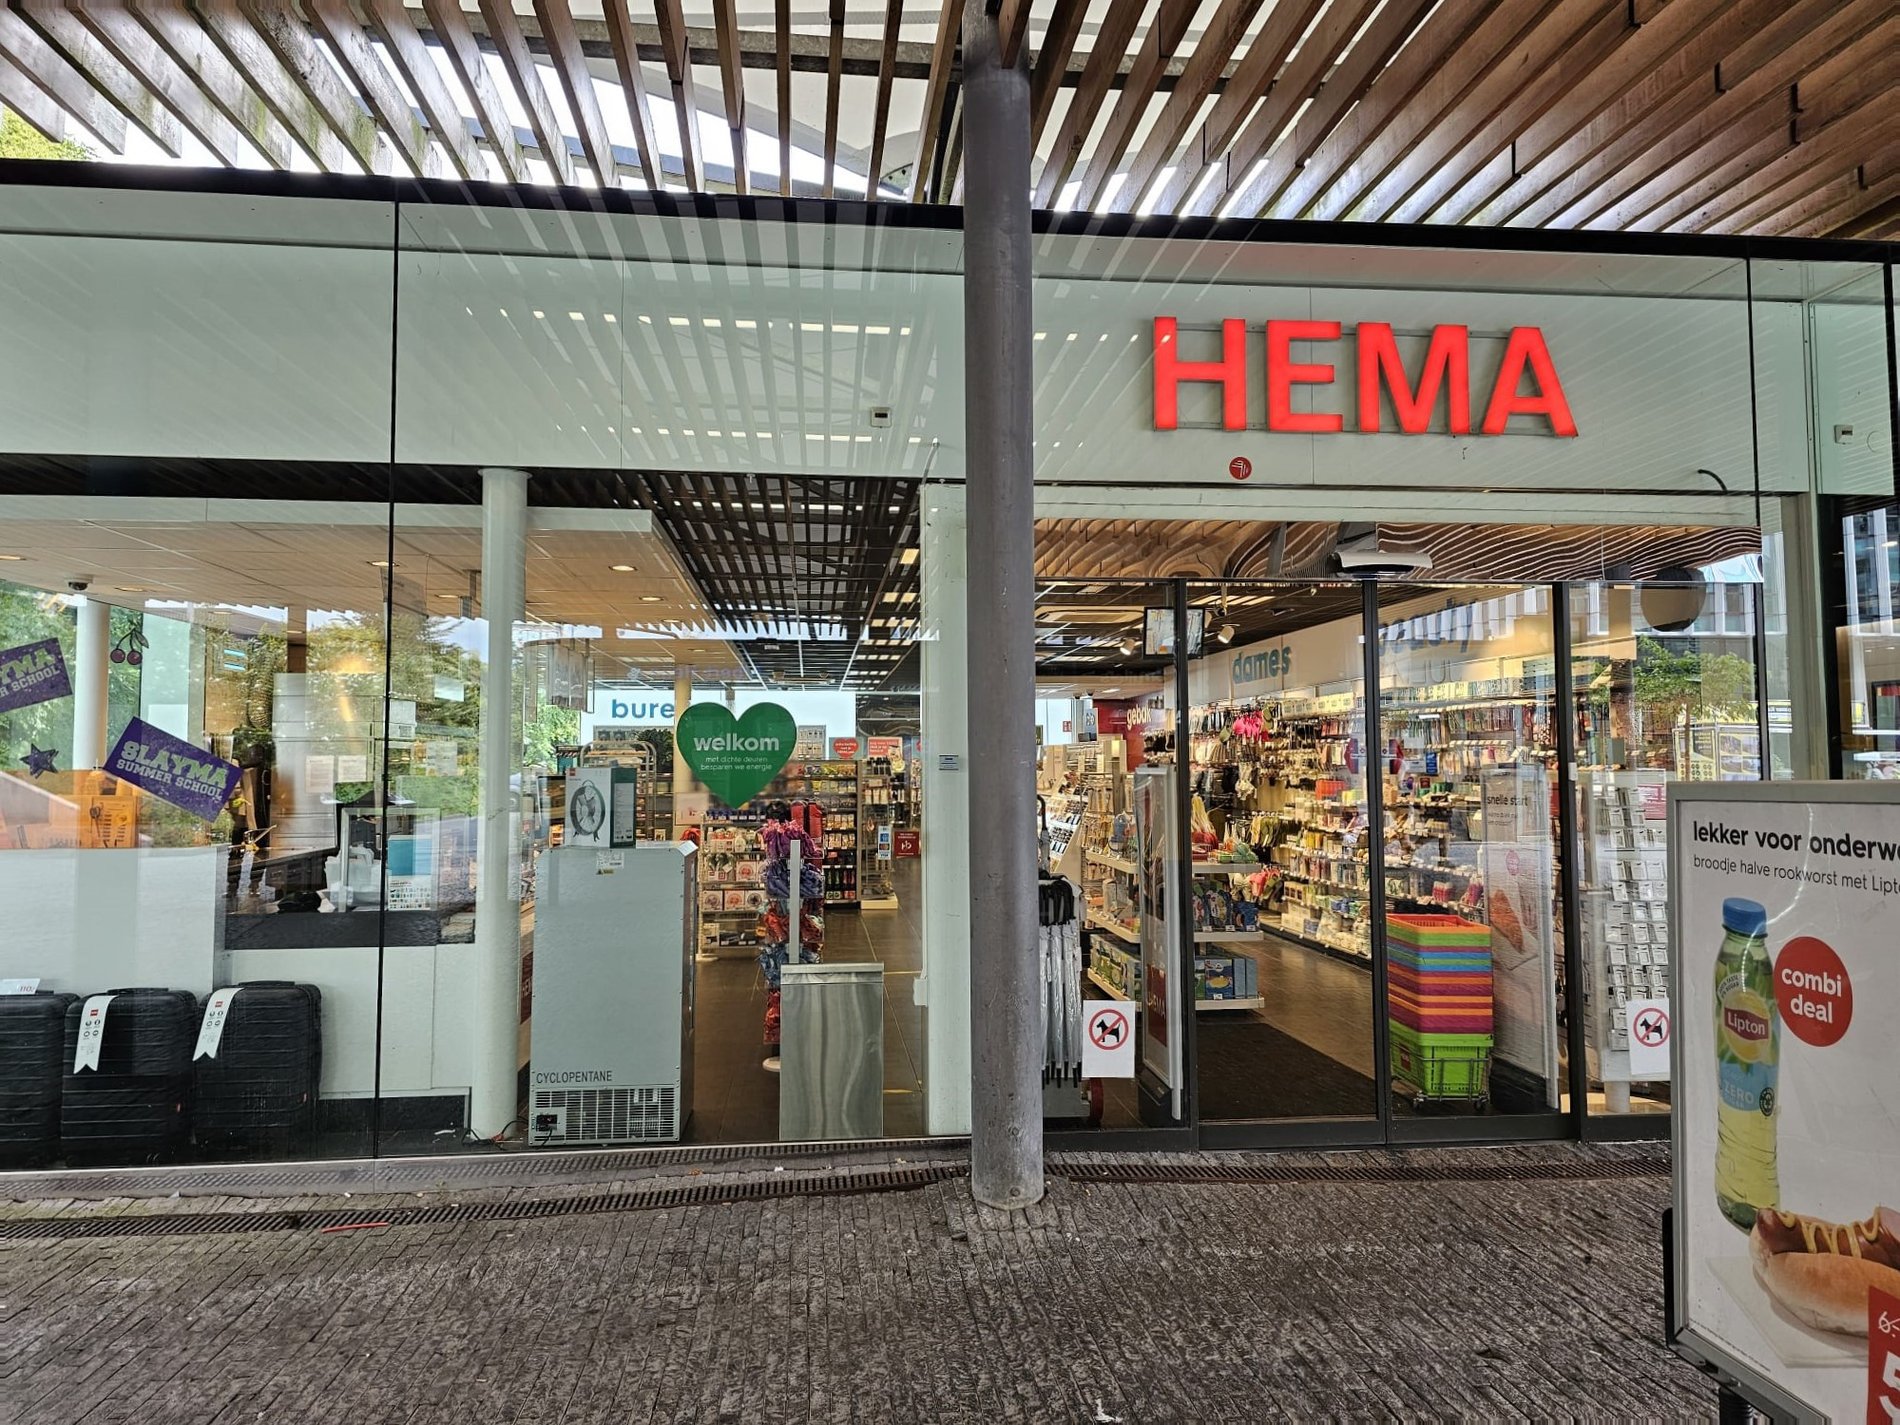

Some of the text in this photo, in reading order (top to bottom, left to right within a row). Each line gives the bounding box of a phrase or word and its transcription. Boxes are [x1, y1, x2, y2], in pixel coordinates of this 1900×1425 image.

[1153, 315, 1579, 437] HEMA
[0, 648, 55, 685] YMA
[11, 665, 60, 691] SCHOOL
[1232, 645, 1291, 684] dames
[611, 698, 675, 718] bure
[1126, 704, 1152, 731] gebak
[693, 732, 780, 751] welkom
[121, 740, 229, 789] SLAYMA
[700, 763, 733, 771] besparen
[746, 764, 772, 772] energie
[116, 758, 223, 801] SUMMER SCHOOL
[1487, 793, 1508, 805] snelle
[1693, 821, 1749, 846] lekker
[1754, 830, 1802, 851] voor
[1693, 854, 1900, 896] broodje halve rookworst met Lipt
[1781, 968, 1842, 997] combi
[1790, 993, 1833, 1024] deal
[1727, 1011, 1766, 1036] Lipton
[536, 1071, 611, 1084] CYCLOPENTANE
[1723, 1081, 1755, 1105] ZERO
